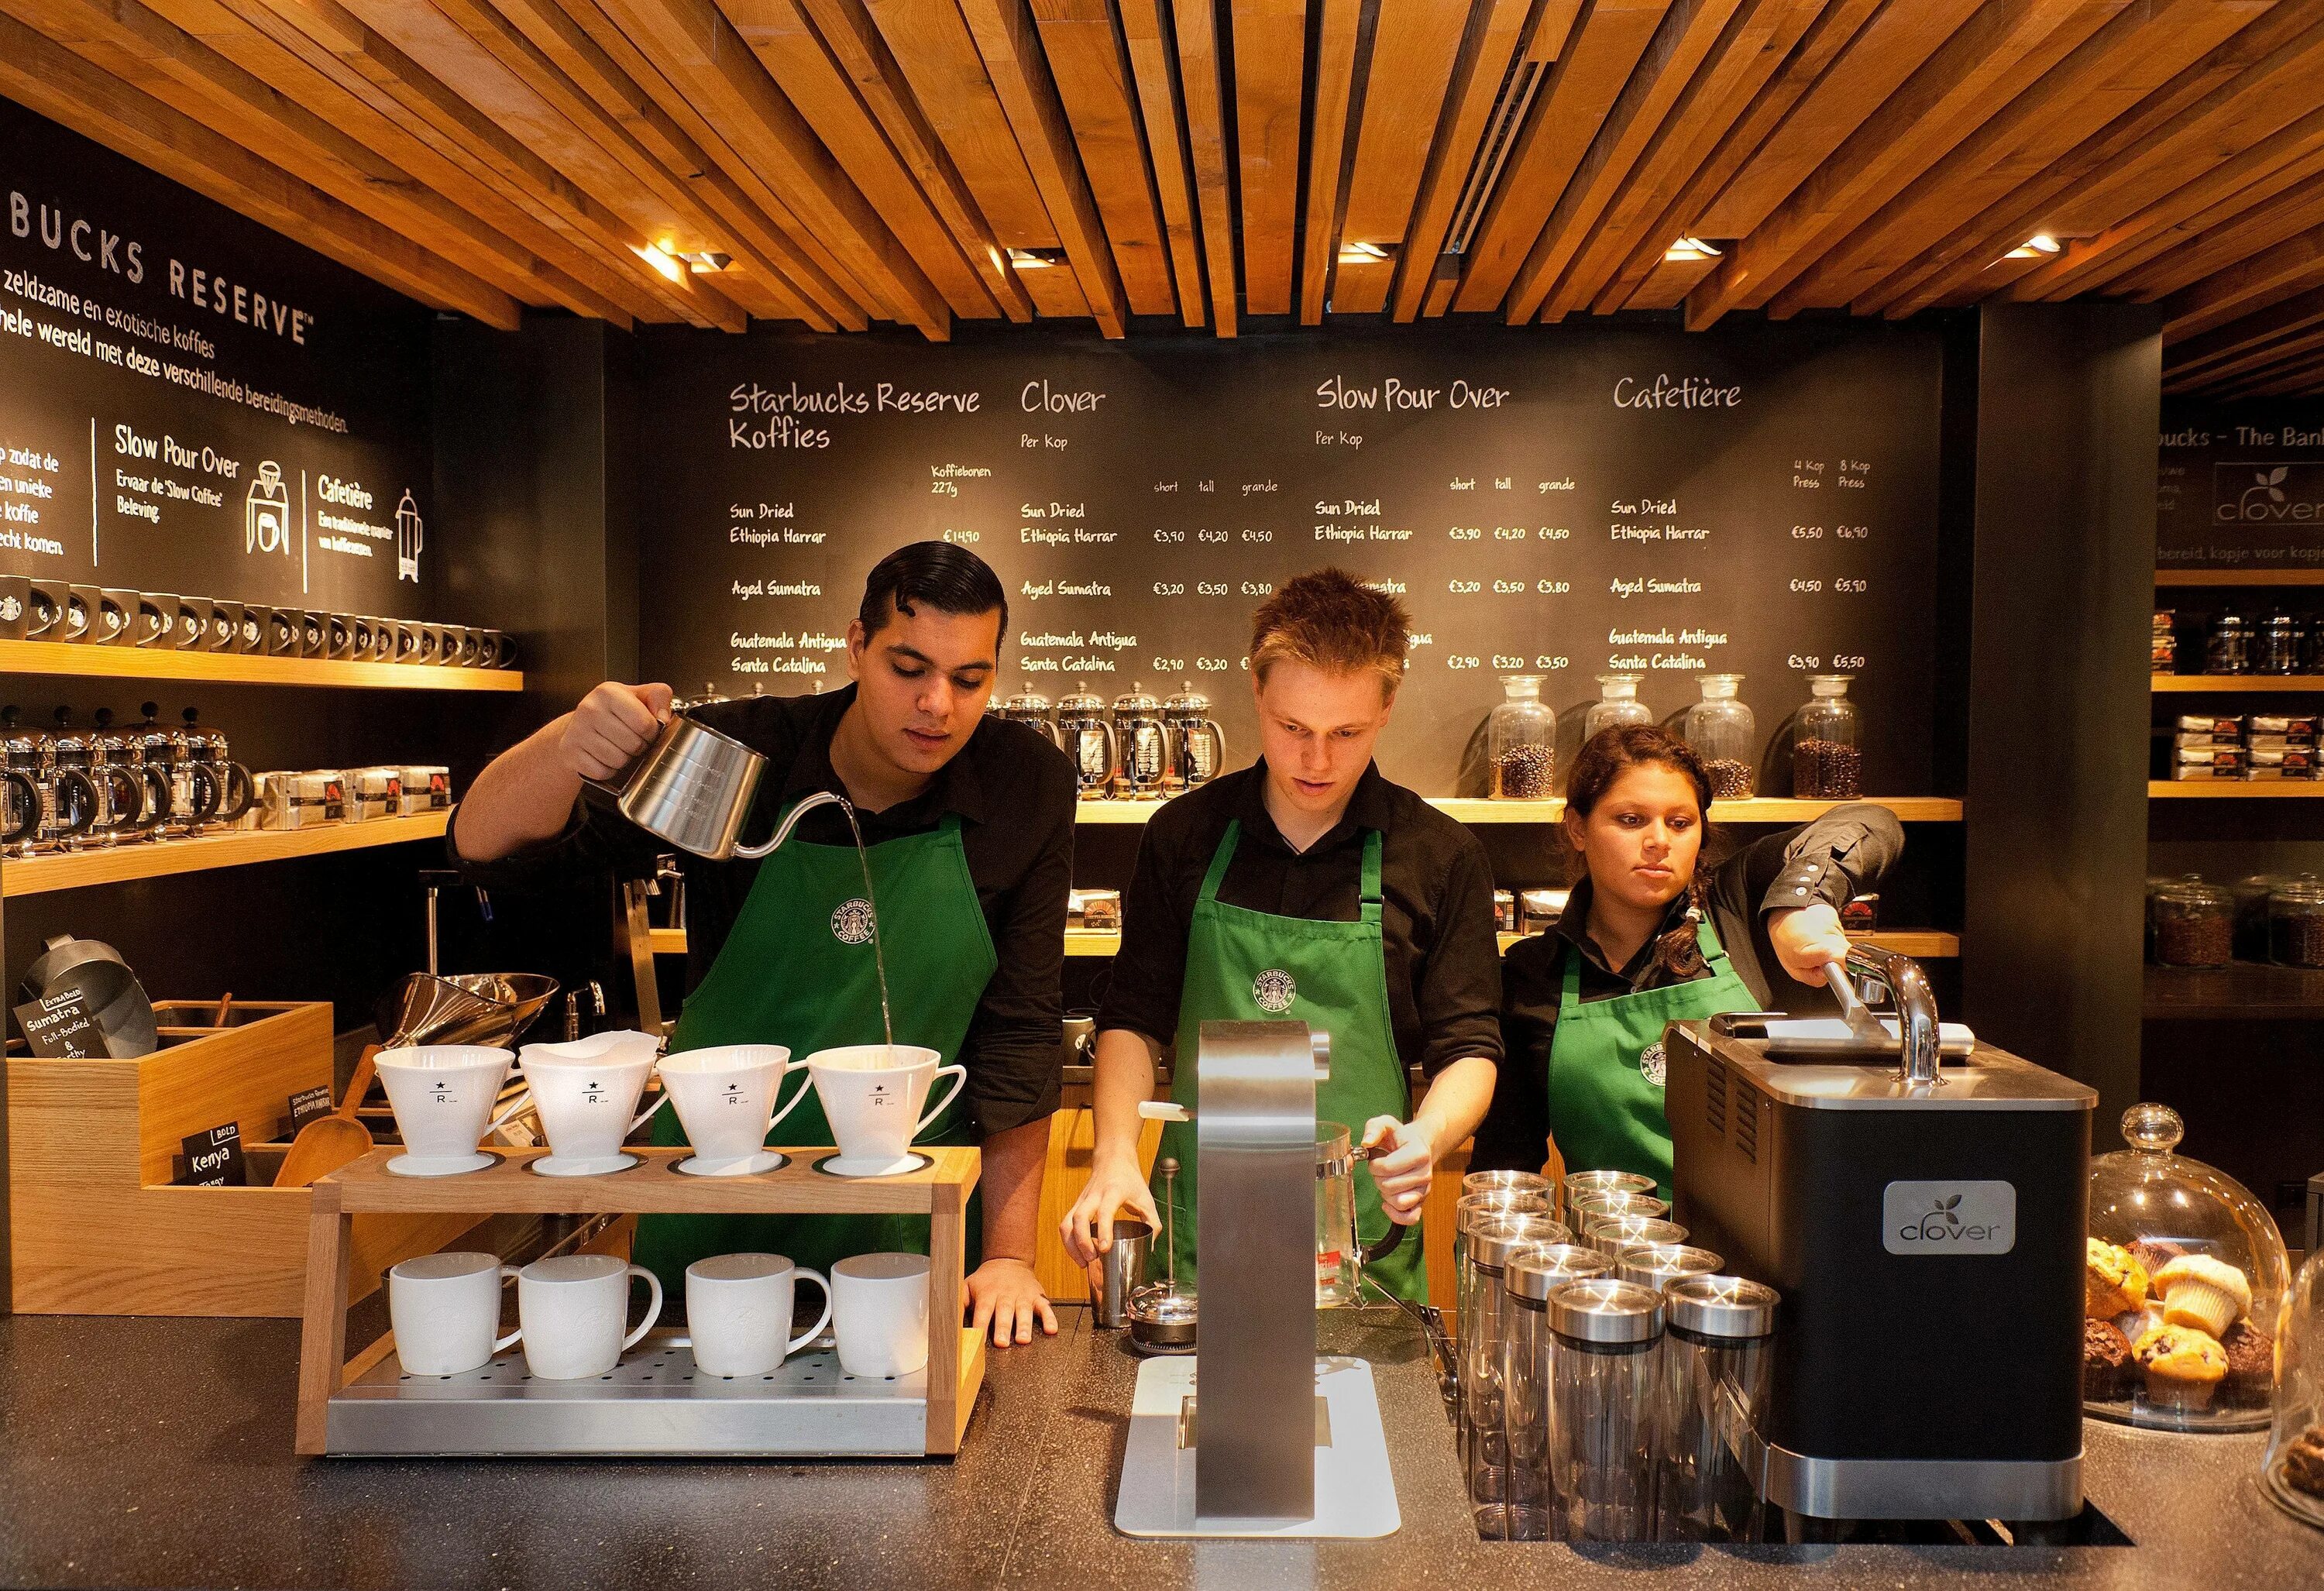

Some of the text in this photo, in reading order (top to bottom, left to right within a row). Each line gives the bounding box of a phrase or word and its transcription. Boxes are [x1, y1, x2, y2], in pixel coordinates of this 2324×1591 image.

[10, 191, 145, 284] BUCKS
[4, 268, 215, 359] zeldzame en exotische koffies
[37, 318, 91, 356] wereld
[96, 338, 123, 367] met
[126, 345, 160, 377] deze
[163, 360, 243, 404] verschillende
[246, 384, 349, 435] bereidingsmethoden.
[730, 383, 981, 414] Starbucks Reserve
[1020, 380, 1107, 414] Clover
[1316, 374, 1510, 412] Slow Pour Over
[1614, 373, 1742, 410] Cafetière
[730, 415, 831, 449] Koffies
[1316, 431, 1363, 449] Per Kop
[2236, 427, 2275, 446] The
[115, 424, 240, 479] Slow Pour Over
[1020, 434, 1067, 452] Per Kop
[9, 447, 42, 469] zodat
[43, 452, 59, 473] de
[1794, 460, 1825, 475] 4 Kop
[1850, 460, 1871, 475] Kop
[931, 464, 992, 478] Koffiebonen
[15, 478, 53, 499] unieke
[116, 469, 149, 493] Ervaar
[151, 476, 163, 497] de
[318, 474, 373, 510] Cafetière
[931, 481, 958, 497] 227g
[1154, 479, 1278, 497] short tall grande
[1450, 478, 1575, 494] short tall grande
[1793, 476, 1865, 489] Press Press
[5, 500, 40, 524] koffie
[730, 503, 794, 519] Sun Dried
[1020, 503, 1085, 519] Sun Dried
[1315, 499, 1381, 517] Sun Dried
[1611, 499, 1677, 515] Sun Dried
[730, 527, 779, 548] Ethiopia
[783, 529, 827, 545] Harrar
[1020, 527, 1273, 548] Ethiopia Harrar €3,90 €4,20 €4,50
[1315, 525, 1365, 544] Ethiopia
[1369, 527, 1413, 541] Harrar
[1611, 525, 1661, 544] Ethiopia
[1666, 526, 1710, 541] Harrar
[731, 579, 821, 601] Aged Sumatra
[1020, 579, 1272, 601] Aged Sumatra €3,20 €3,50 €3,80
[1610, 579, 1643, 599] Aged
[1647, 578, 1702, 594] Sumatra
[731, 631, 847, 651] Guatemala Antigua
[1020, 631, 1137, 653] Guatemala Antigua
[1609, 627, 1728, 649] Guatemala Antigua
[731, 658, 827, 674] Santa Catalina
[1020, 658, 1059, 673] Santa
[1062, 658, 1116, 673] Catalina
[1153, 657, 1184, 672] €2,90
[1197, 657, 1228, 672] €3,20
[1609, 653, 1648, 670] Santa
[1652, 653, 1706, 670] Catalina
[834, 901, 874, 920] STARBUCKS
[838, 930, 870, 942] COFFEE
[1257, 971, 1294, 990] STARBUCKS
[1258, 997, 1287, 1010] COFFEE
[26, 1006, 81, 1032] Sumatra
[41, 1017, 91, 1046] Full-Bodied
[57, 1049, 86, 1059] rthy
[64, 1040, 74, 1051] &
[1642, 1043, 1663, 1064] STARB
[437, 1094, 445, 1103] R
[589, 1094, 597, 1104] R
[729, 1097, 737, 1105] R
[216, 1125, 235, 1139] BOLD
[192, 1147, 230, 1173] Kenya
[1900, 1212, 2000, 1241] clover
